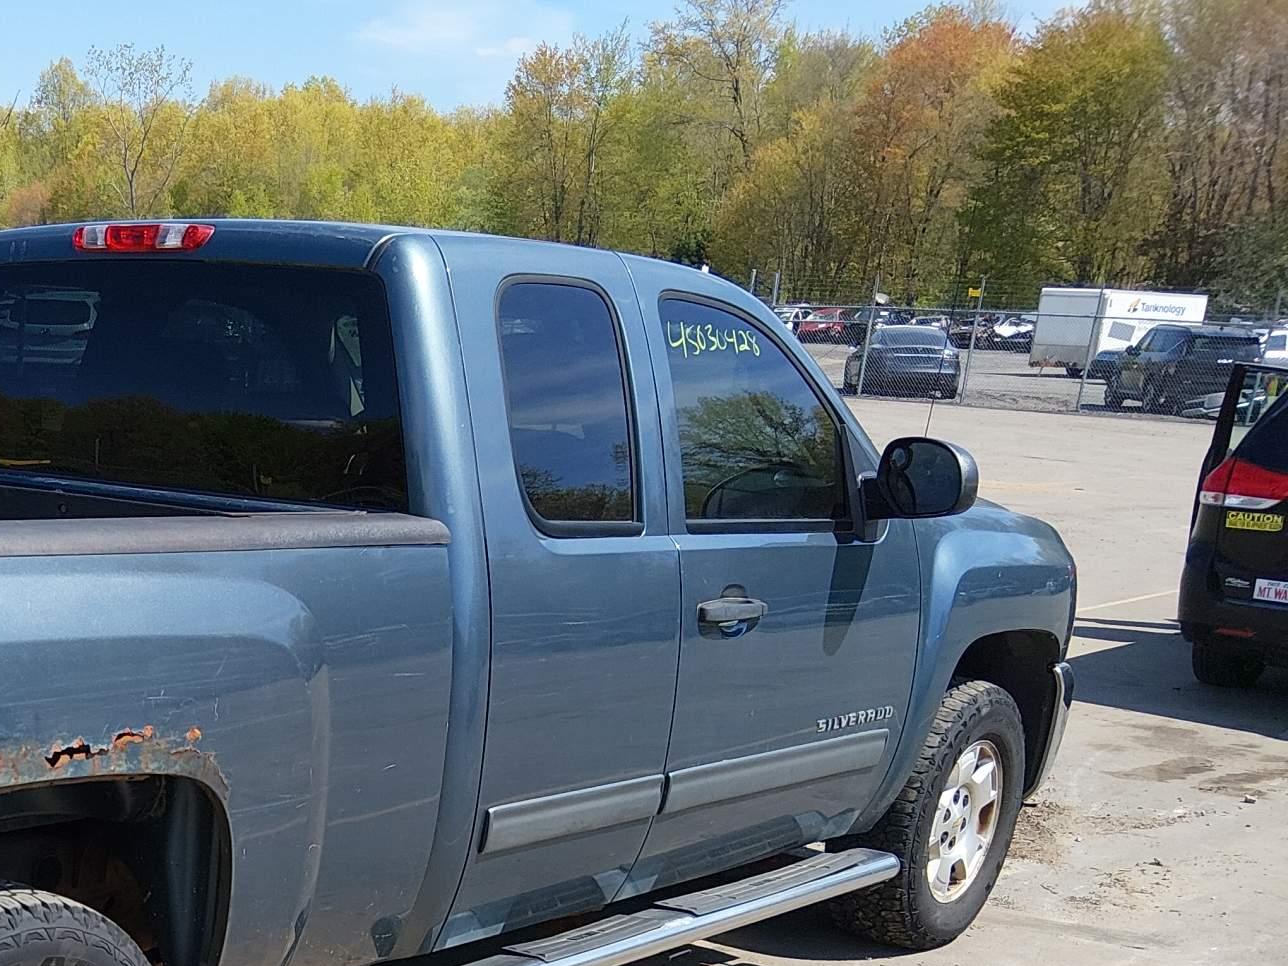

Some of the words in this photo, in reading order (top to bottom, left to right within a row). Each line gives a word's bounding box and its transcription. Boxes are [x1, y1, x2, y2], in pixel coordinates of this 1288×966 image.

[1140, 302, 1186, 316] Tanknology
[666, 319, 761, 359] 45030428
[1228, 511, 1282, 524] CAUTION
[816, 705, 894, 733] SILVERADO
